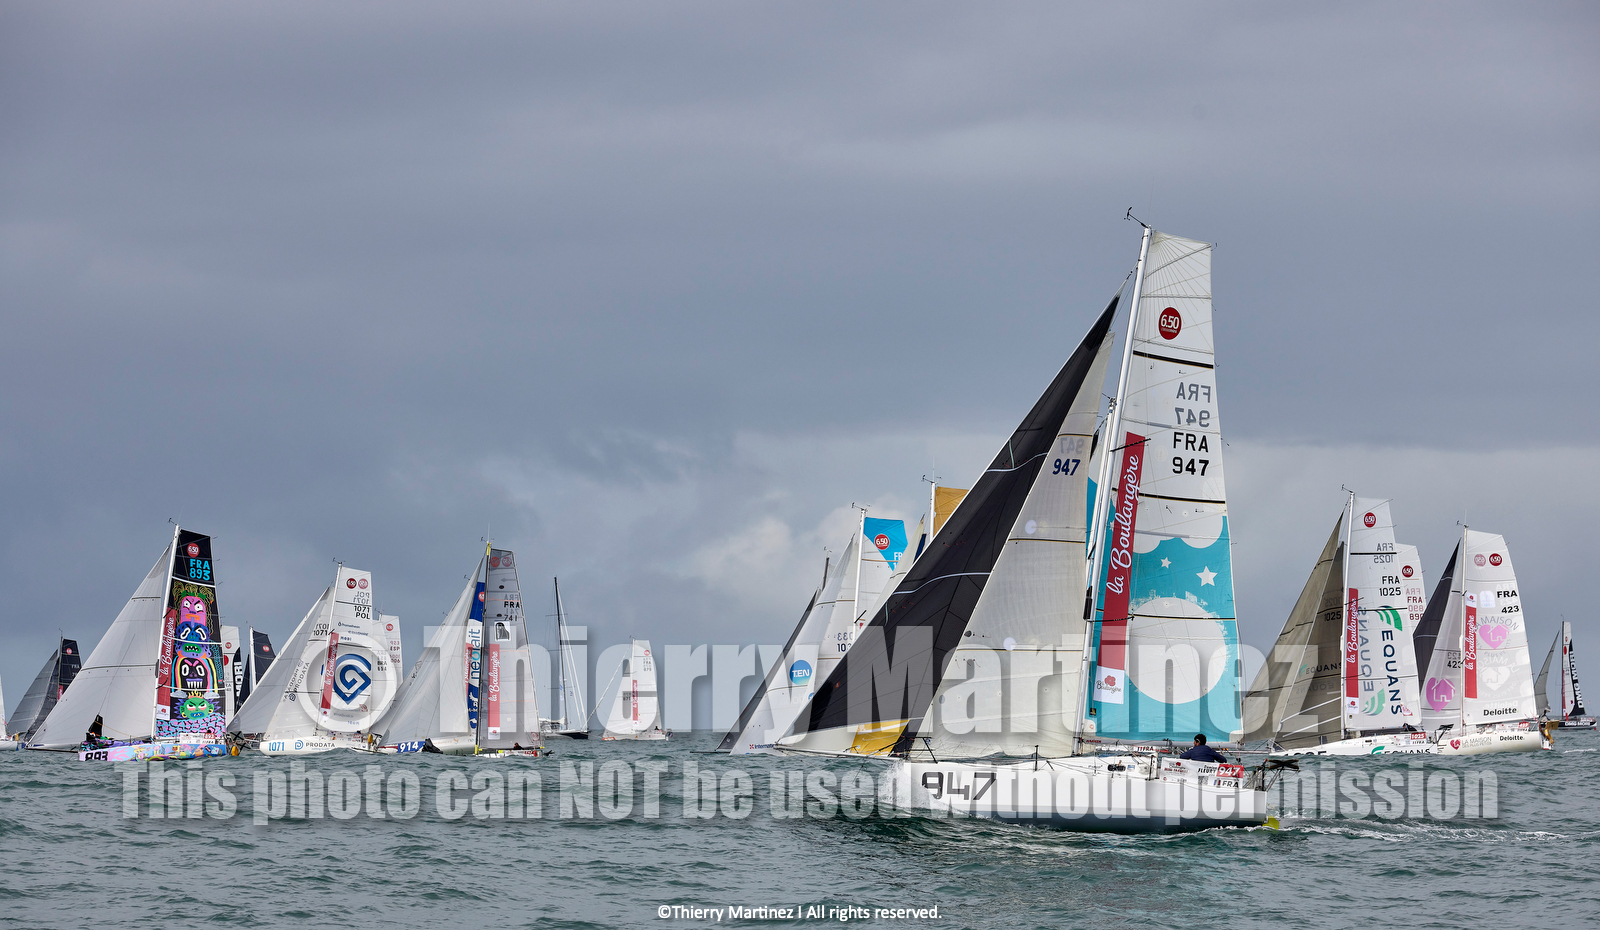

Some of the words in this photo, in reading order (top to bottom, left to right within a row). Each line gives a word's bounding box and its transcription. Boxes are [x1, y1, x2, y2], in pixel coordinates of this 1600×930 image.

[1160, 314, 1180, 330] 6.50
[1173, 432, 1209, 453] FRA
[1052, 458, 1081, 476] 947
[1172, 456, 1210, 477] 947
[1110, 454, 1139, 570] Boulangère
[1364, 515, 1376, 523] 6.50
[876, 537, 889, 545] 6.50
[189, 558, 211, 571] FRA
[189, 567, 211, 581] 893
[1106, 575, 1124, 595] la
[1382, 575, 1401, 585] FRA
[1379, 587, 1402, 597] 1025
[1496, 590, 1518, 599] FRA
[503, 601, 521, 609] FRA
[1407, 596, 1423, 604] FRA
[354, 605, 370, 613] 1071
[1501, 605, 1520, 614] 423
[355, 611, 371, 620] POL
[503, 614, 518, 622] 741
[1324, 610, 1342, 622] 1025
[1347, 598, 1359, 653] Boulangère
[1480, 615, 1519, 631] MAISON
[1345, 654, 1356, 664] la
[1381, 629, 1403, 715] EQUANS
[1470, 736, 1492, 744] MAISON
[268, 741, 285, 752] 1071
[400, 741, 419, 753] 914
[85, 750, 109, 761] 893
[1218, 766, 1241, 777] 947
[922, 771, 997, 800] 947
[1222, 780, 1239, 788] FRA
